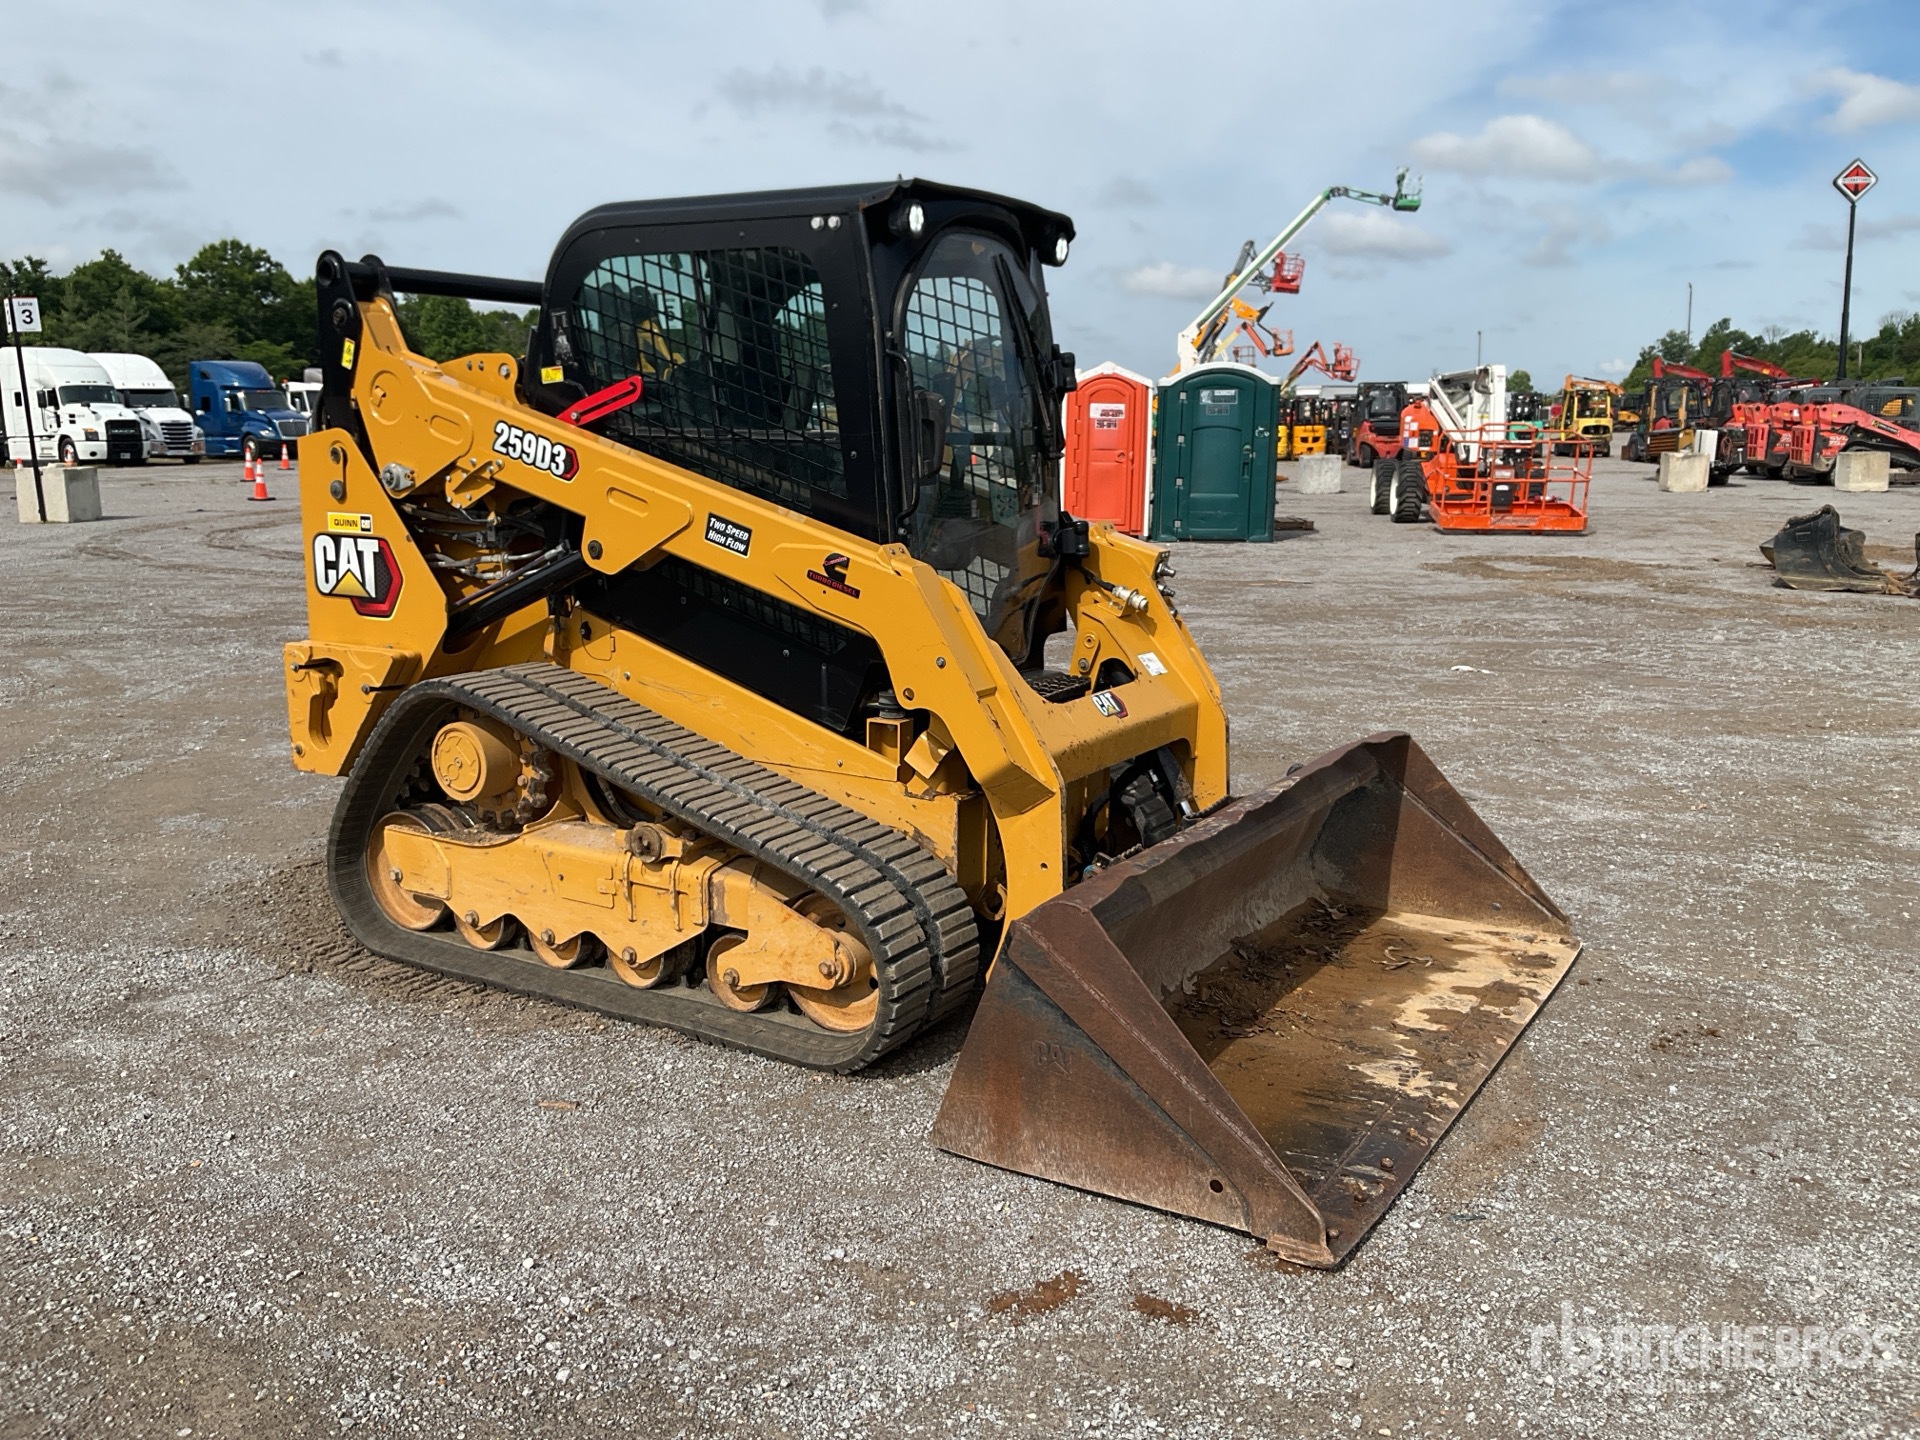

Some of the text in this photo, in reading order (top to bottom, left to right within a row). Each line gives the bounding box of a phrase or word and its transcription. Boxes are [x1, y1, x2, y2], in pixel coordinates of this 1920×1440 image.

[21, 309, 34, 325] 3
[493, 421, 567, 476] 259D3
[334, 519, 358, 527] QUINN
[314, 535, 379, 598] CAT
[809, 571, 857, 596] TURBO DIESEL
[1091, 692, 1121, 717] CAT
